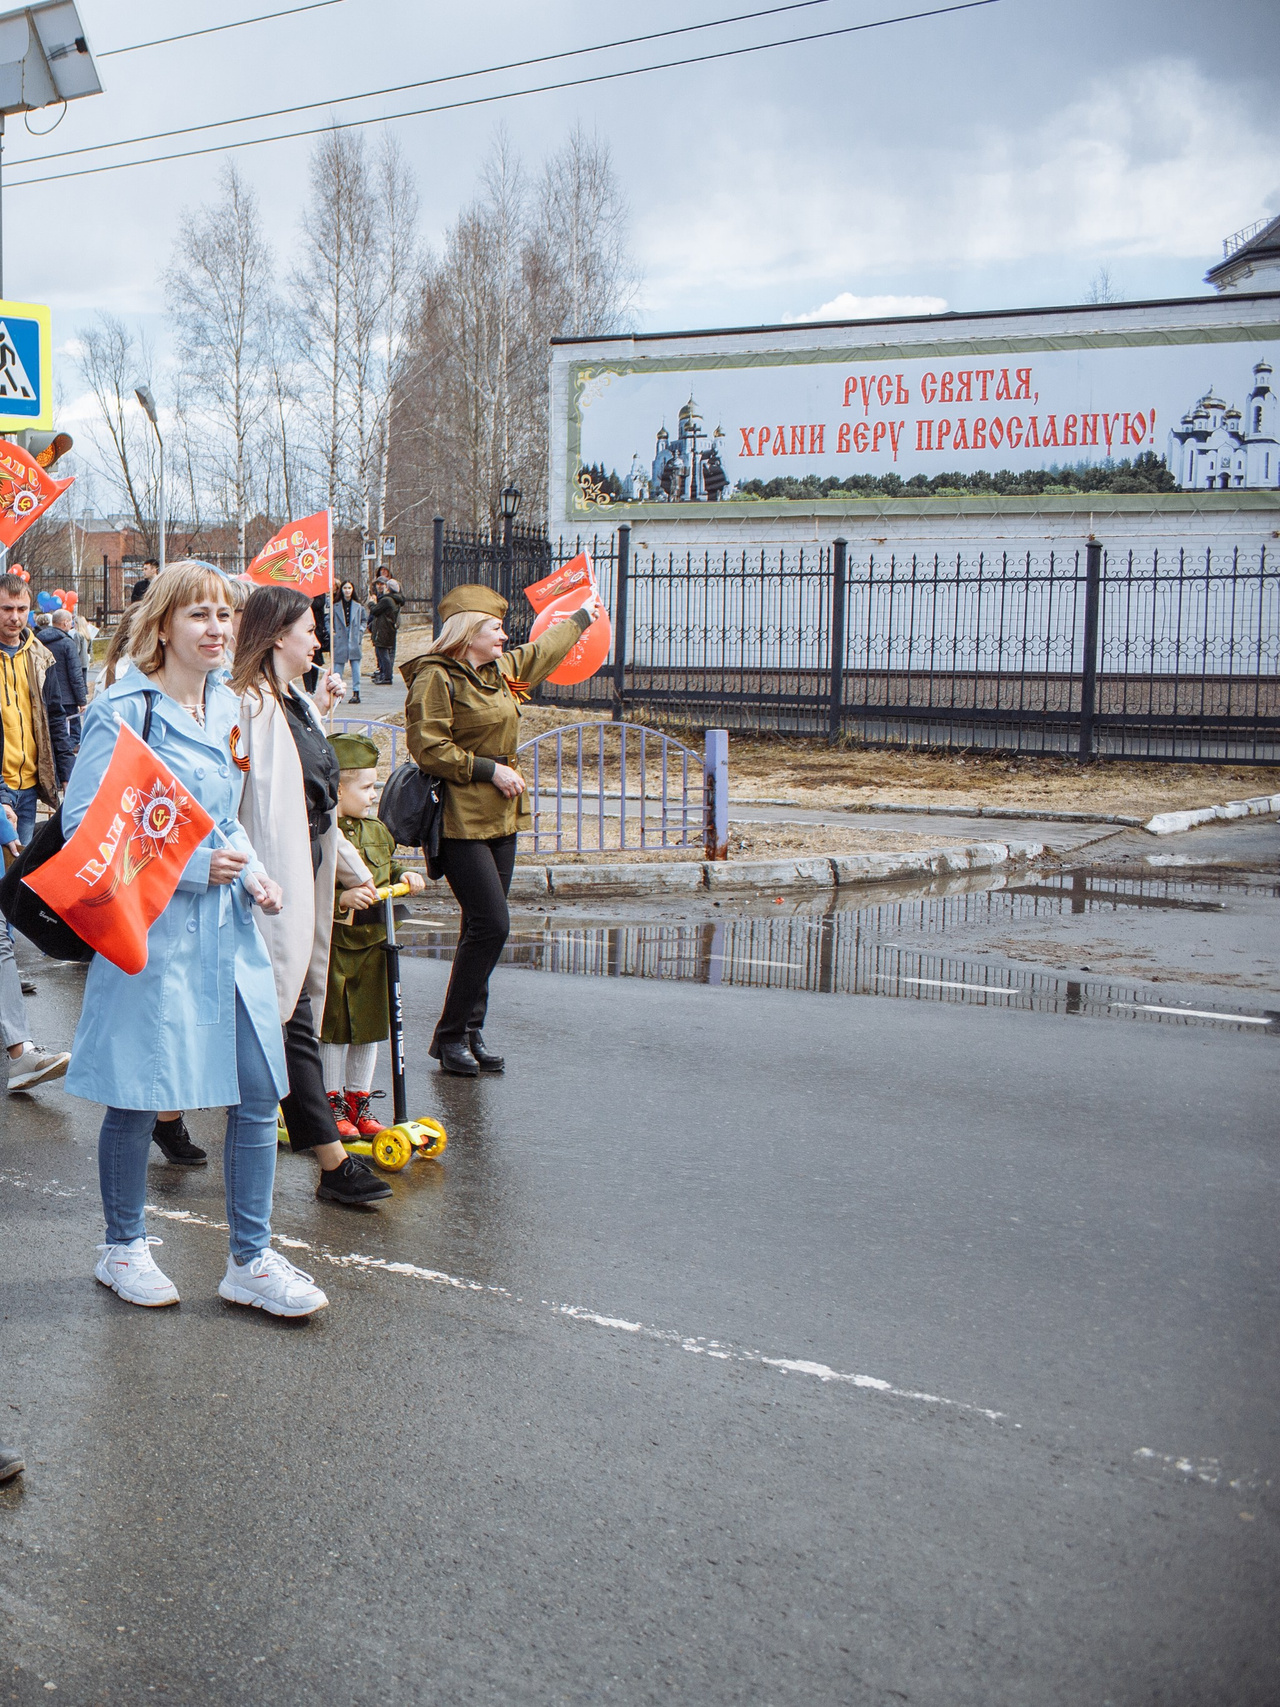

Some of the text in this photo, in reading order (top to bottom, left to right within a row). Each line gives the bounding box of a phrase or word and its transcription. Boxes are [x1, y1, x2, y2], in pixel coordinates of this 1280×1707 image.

[842, 367, 1039, 416] РУСЬ СВЯТАЯ,
[738, 407, 1156, 462] ХРАНИ ВЕРУ ПРАВОСЛАВНУЮ!
